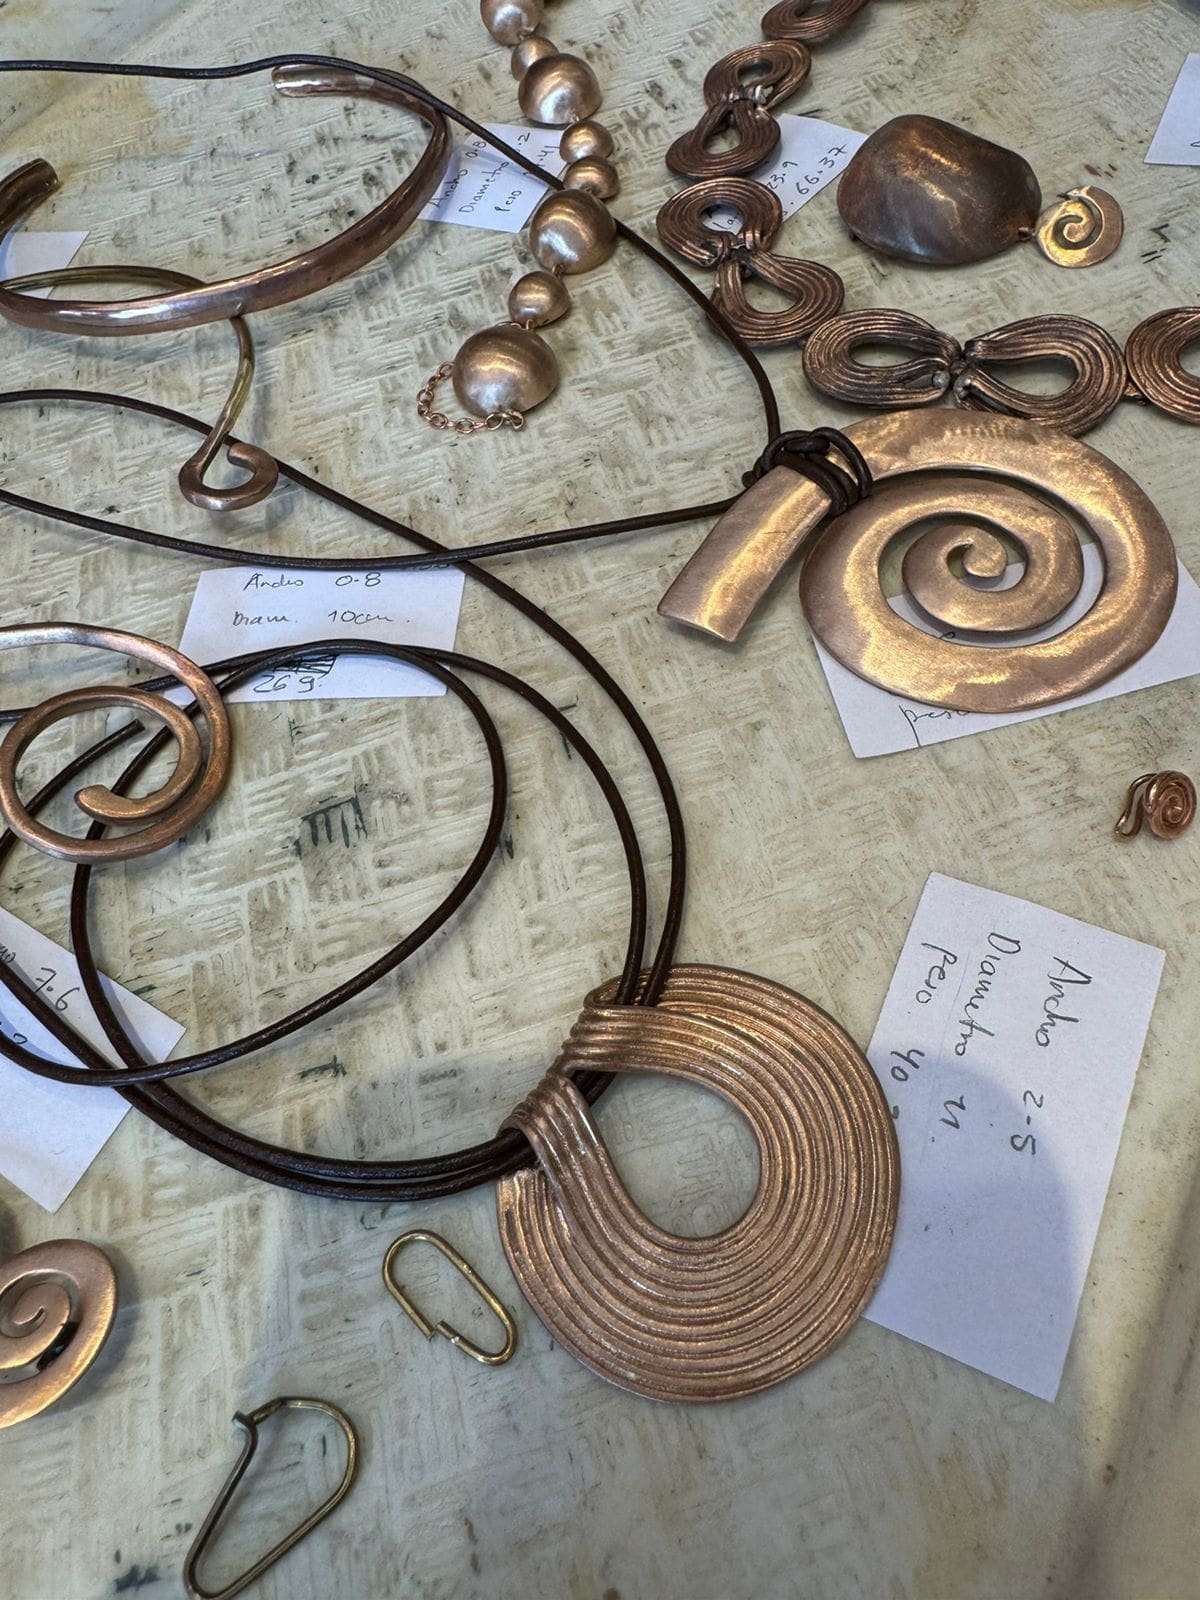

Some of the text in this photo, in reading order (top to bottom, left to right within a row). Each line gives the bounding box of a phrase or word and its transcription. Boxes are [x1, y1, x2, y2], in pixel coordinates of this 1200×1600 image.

[795, 144, 848, 195] 66.37
[954, 932, 1022, 1057] Diametro
[1034, 955, 1093, 1048] Ancho
